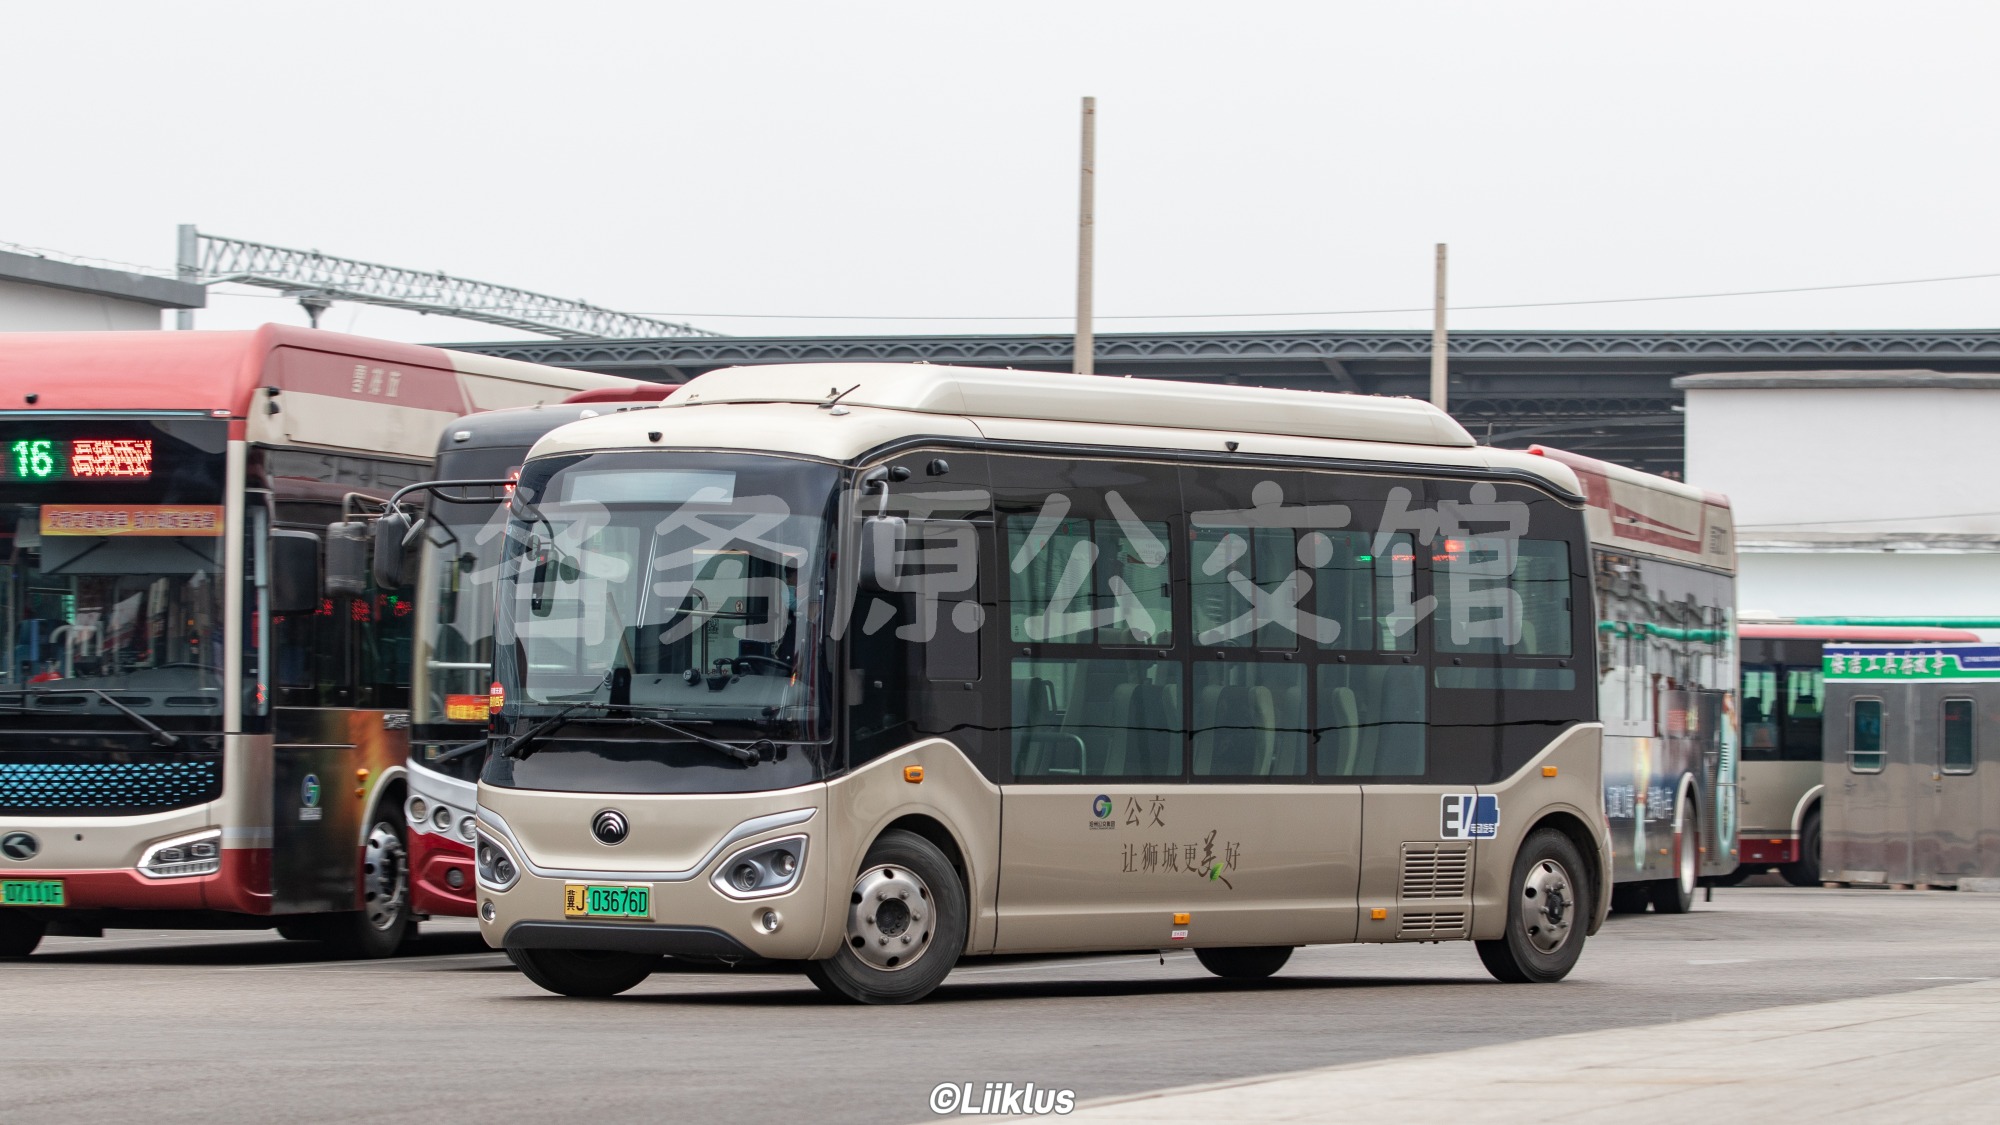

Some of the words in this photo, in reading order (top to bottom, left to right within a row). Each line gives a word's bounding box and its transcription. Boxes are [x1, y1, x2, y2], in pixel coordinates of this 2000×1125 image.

[12, 440, 53, 477] 16
[1124, 794, 1166, 829] 公交
[1442, 795, 1479, 838] EV
[1470, 823, 1495, 834] 电动汽车
[1121, 829, 1241, 890] 让狮城更美好
